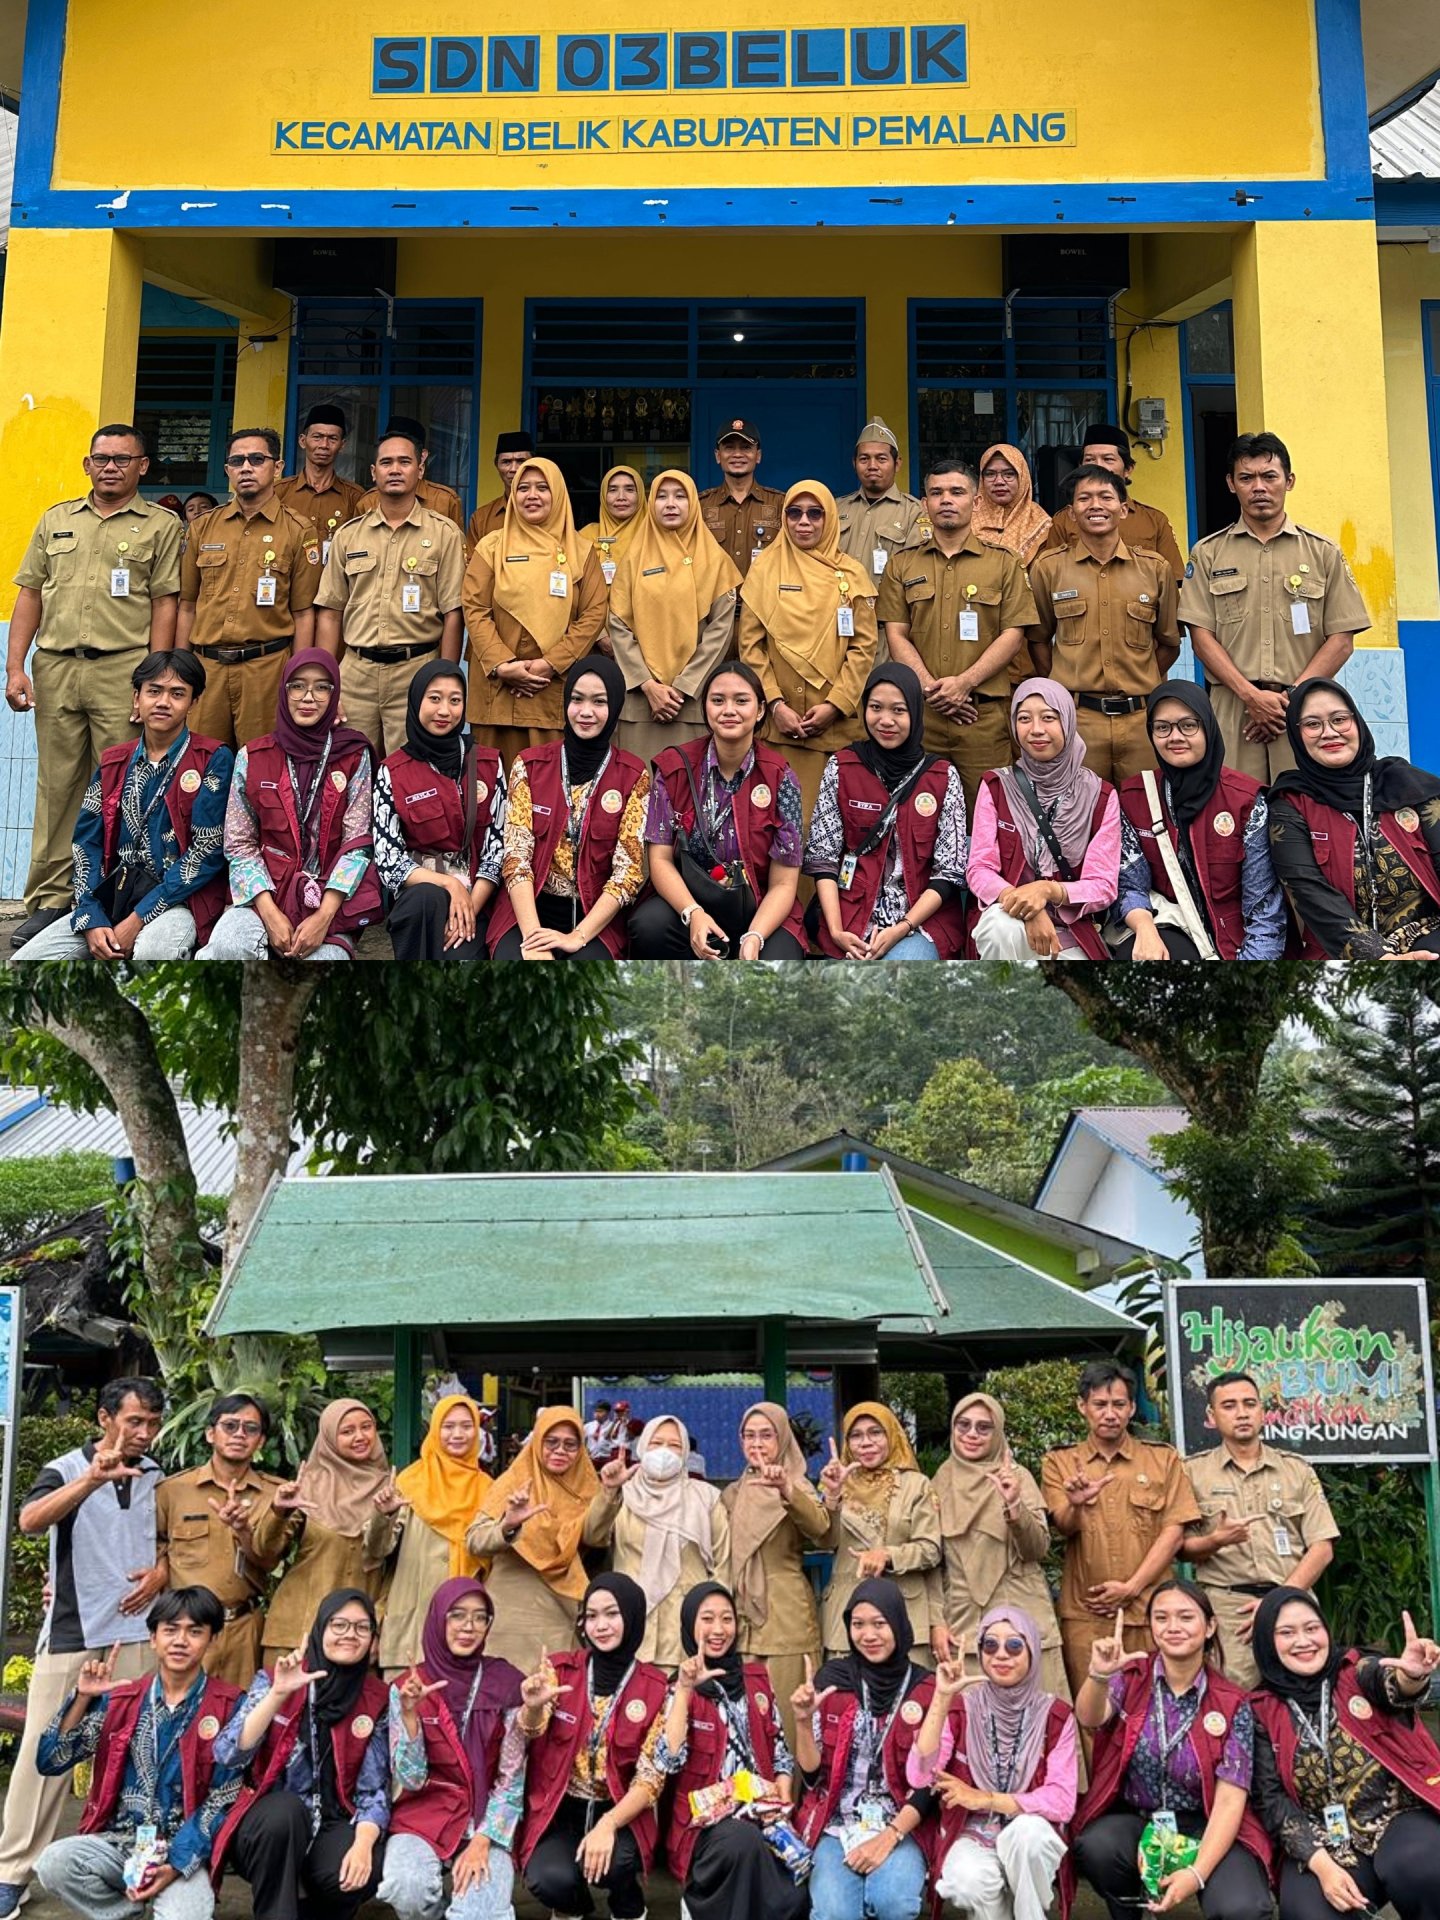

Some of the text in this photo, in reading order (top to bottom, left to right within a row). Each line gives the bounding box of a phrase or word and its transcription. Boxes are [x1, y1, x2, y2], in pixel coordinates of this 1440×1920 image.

[378, 40, 536, 89] SDN
[275, 112, 1066, 150] KECAMATAN BELIK KABUPATEN PEMALANG
[1181, 1305, 1396, 1377] Hijaukan
[1276, 1359, 1401, 1398] BUMI
